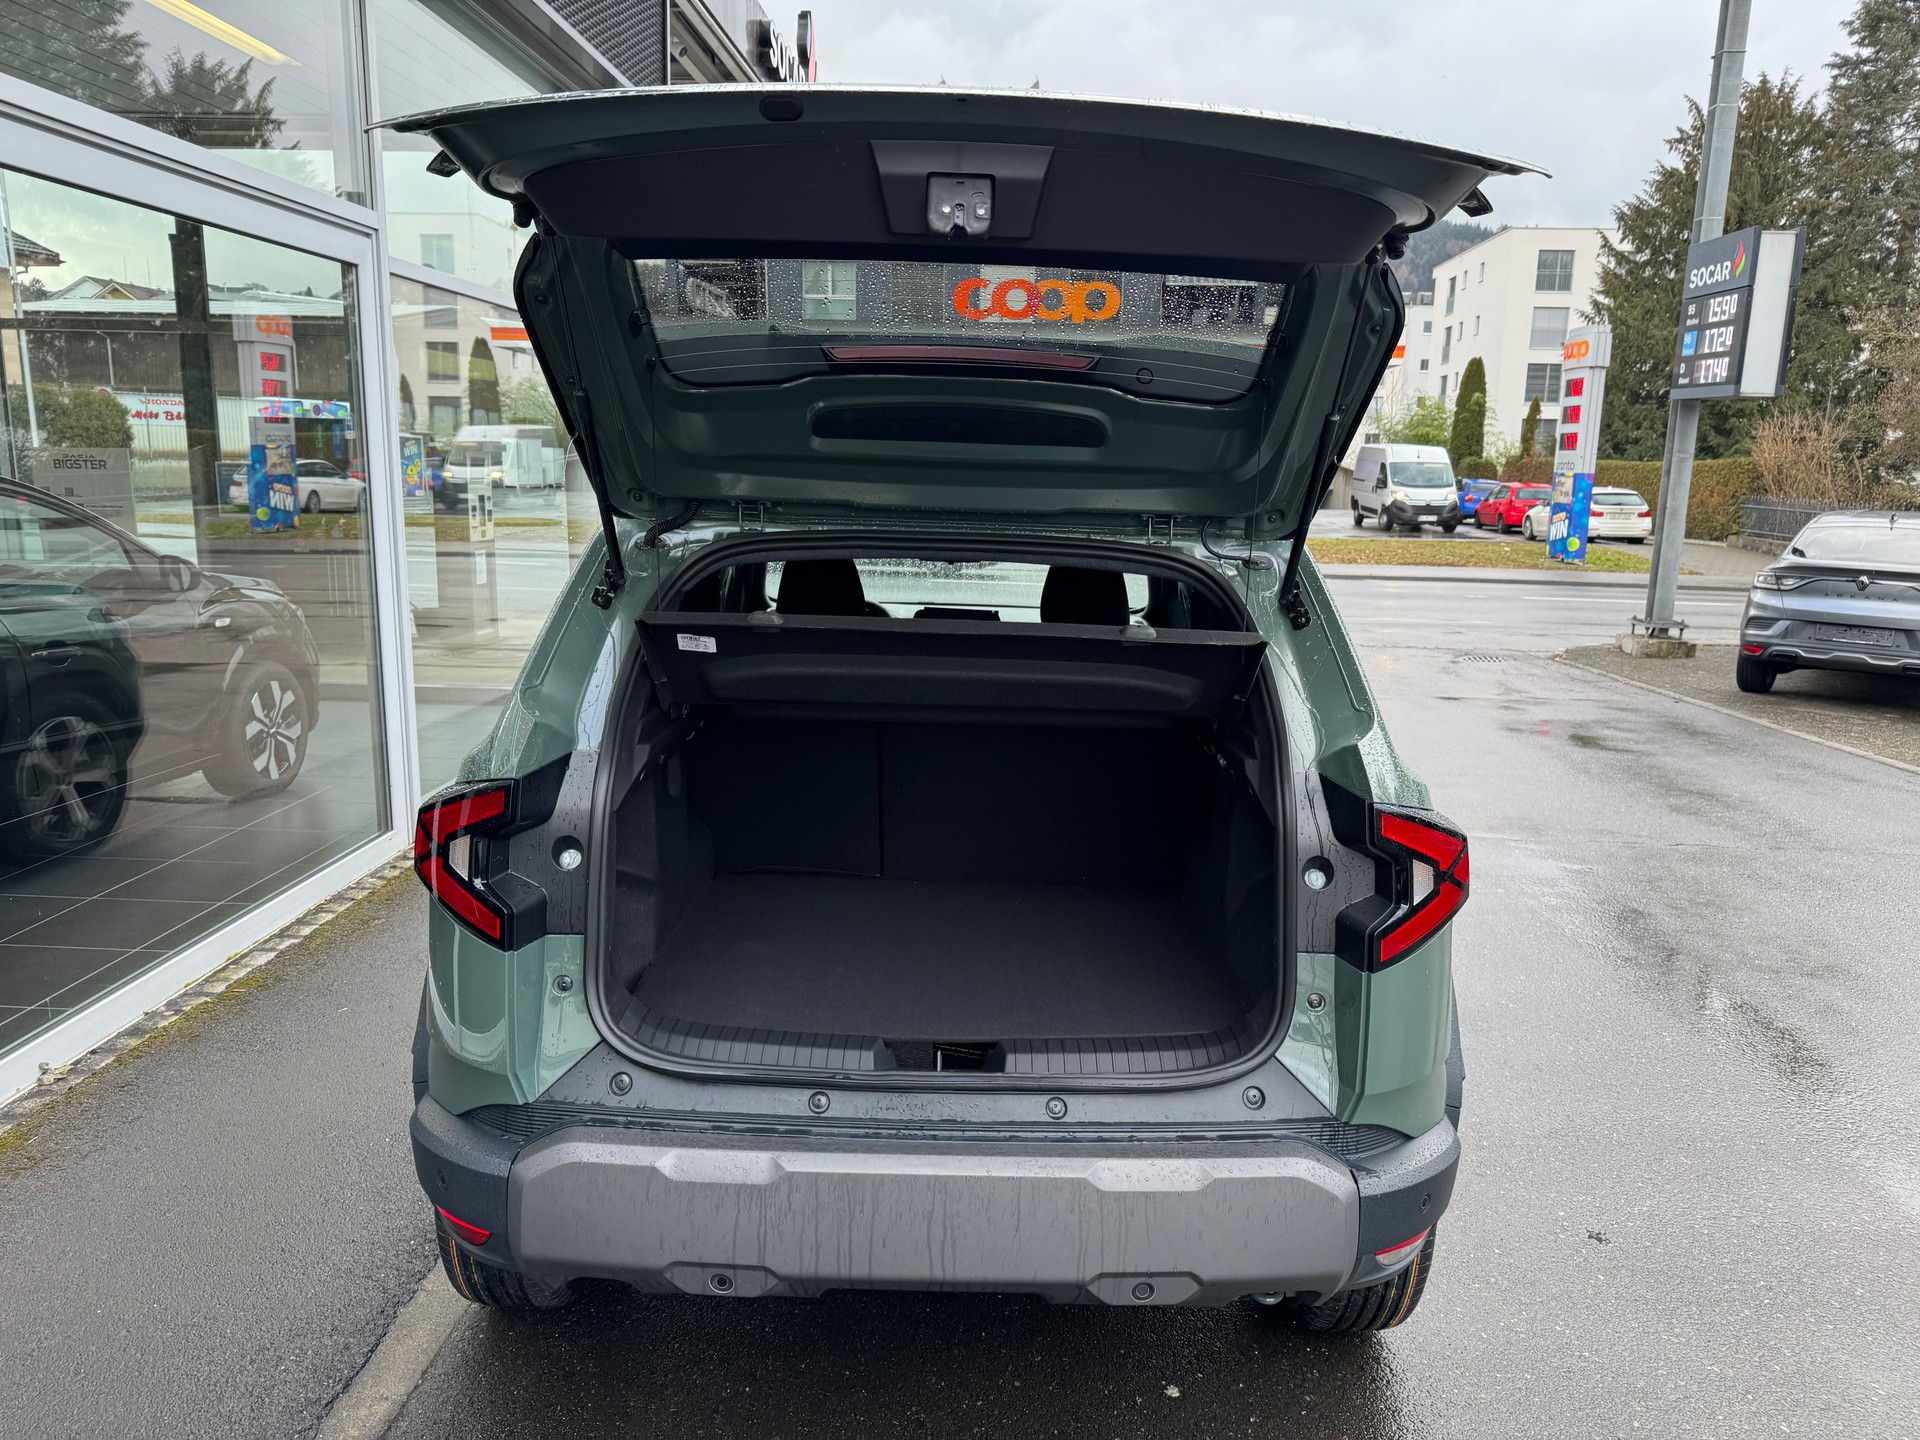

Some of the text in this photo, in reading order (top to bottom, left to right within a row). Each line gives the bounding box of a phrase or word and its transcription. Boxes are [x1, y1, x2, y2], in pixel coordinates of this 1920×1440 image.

[1688, 261, 1732, 290] SOCAR
[953, 277, 1121, 324] coop
[1687, 303, 1696, 316] 95
[1680, 362, 1686, 374] D
[146, 398, 185, 407] HONDA
[53, 459, 107, 470] BIGSTER
[1823, 592, 1898, 602] ARKANA
